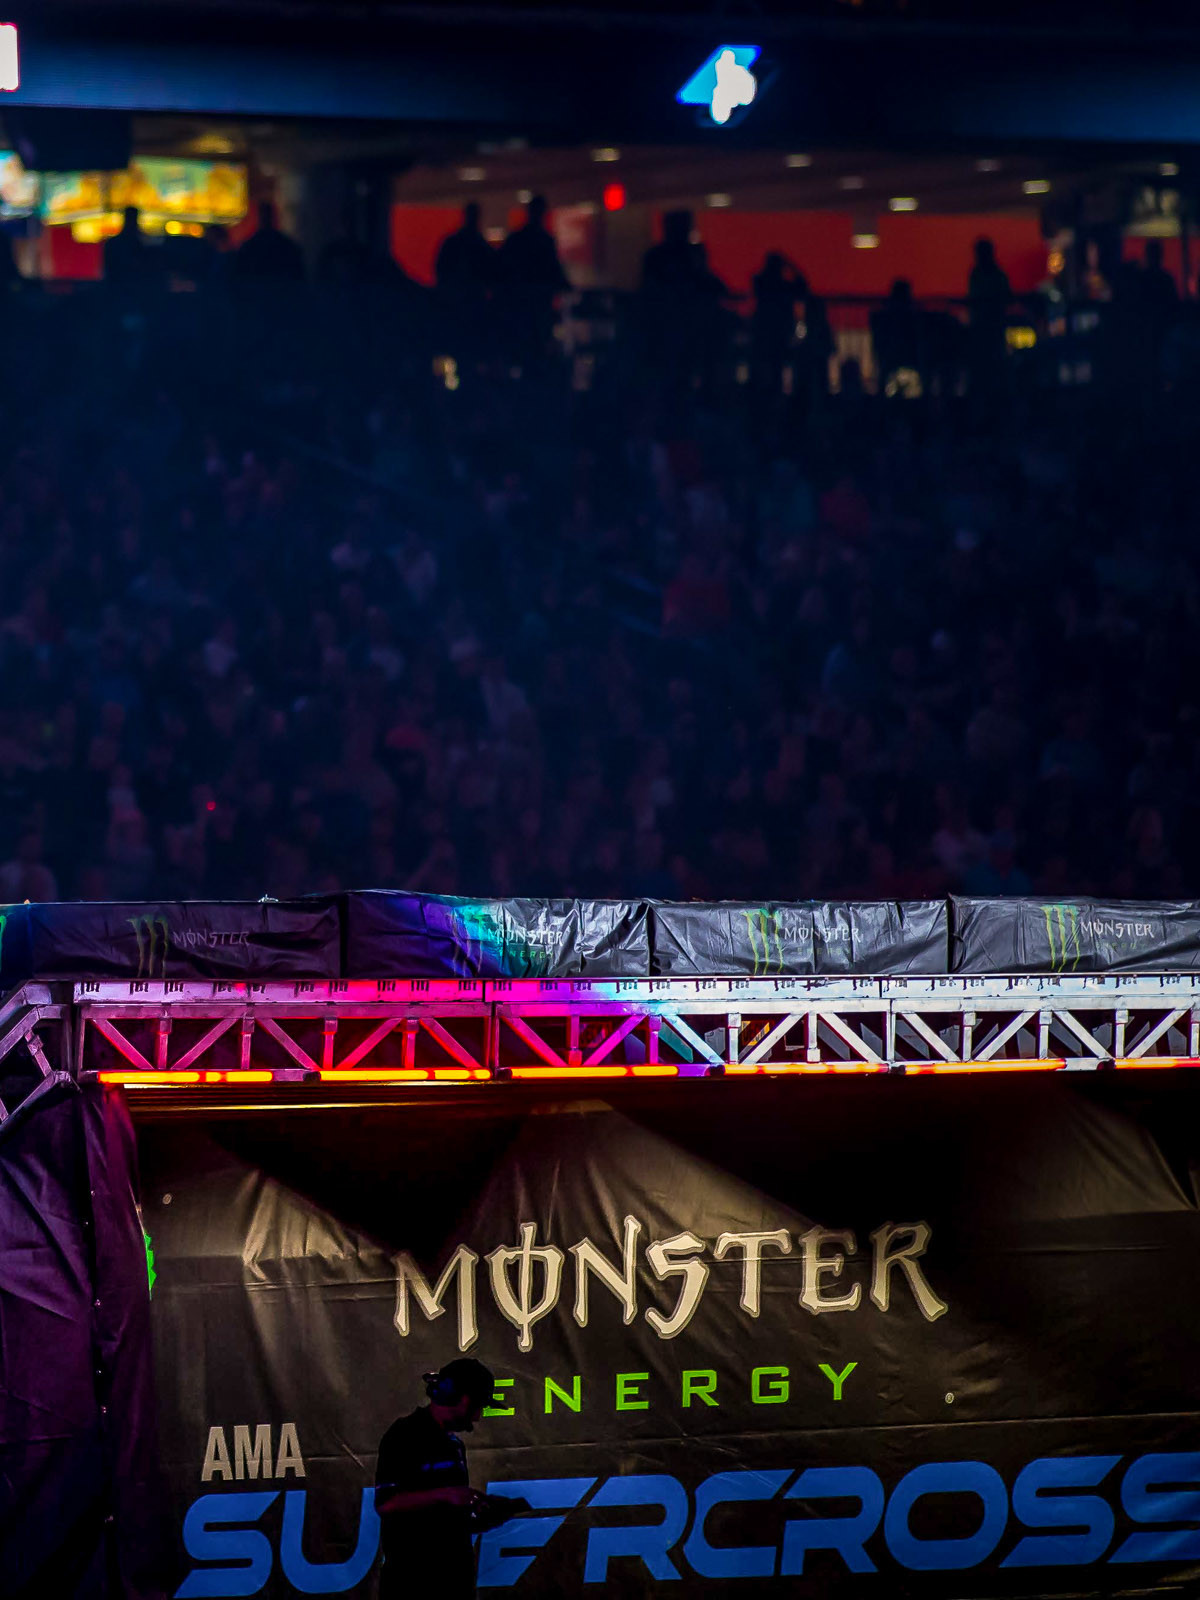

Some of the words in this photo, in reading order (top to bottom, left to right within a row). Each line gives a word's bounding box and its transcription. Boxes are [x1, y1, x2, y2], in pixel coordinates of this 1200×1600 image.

[173, 927, 250, 948] MONSTER
[487, 927, 564, 946] MONSTER
[784, 924, 862, 944] MONSTER
[1080, 919, 1155, 939] MONSTER
[388, 1214, 949, 1352] MONSTER
[482, 1362, 858, 1417] ENERGY
[201, 1422, 307, 1482] AMA
[173, 1452, 1200, 1599] SUERCROSS
